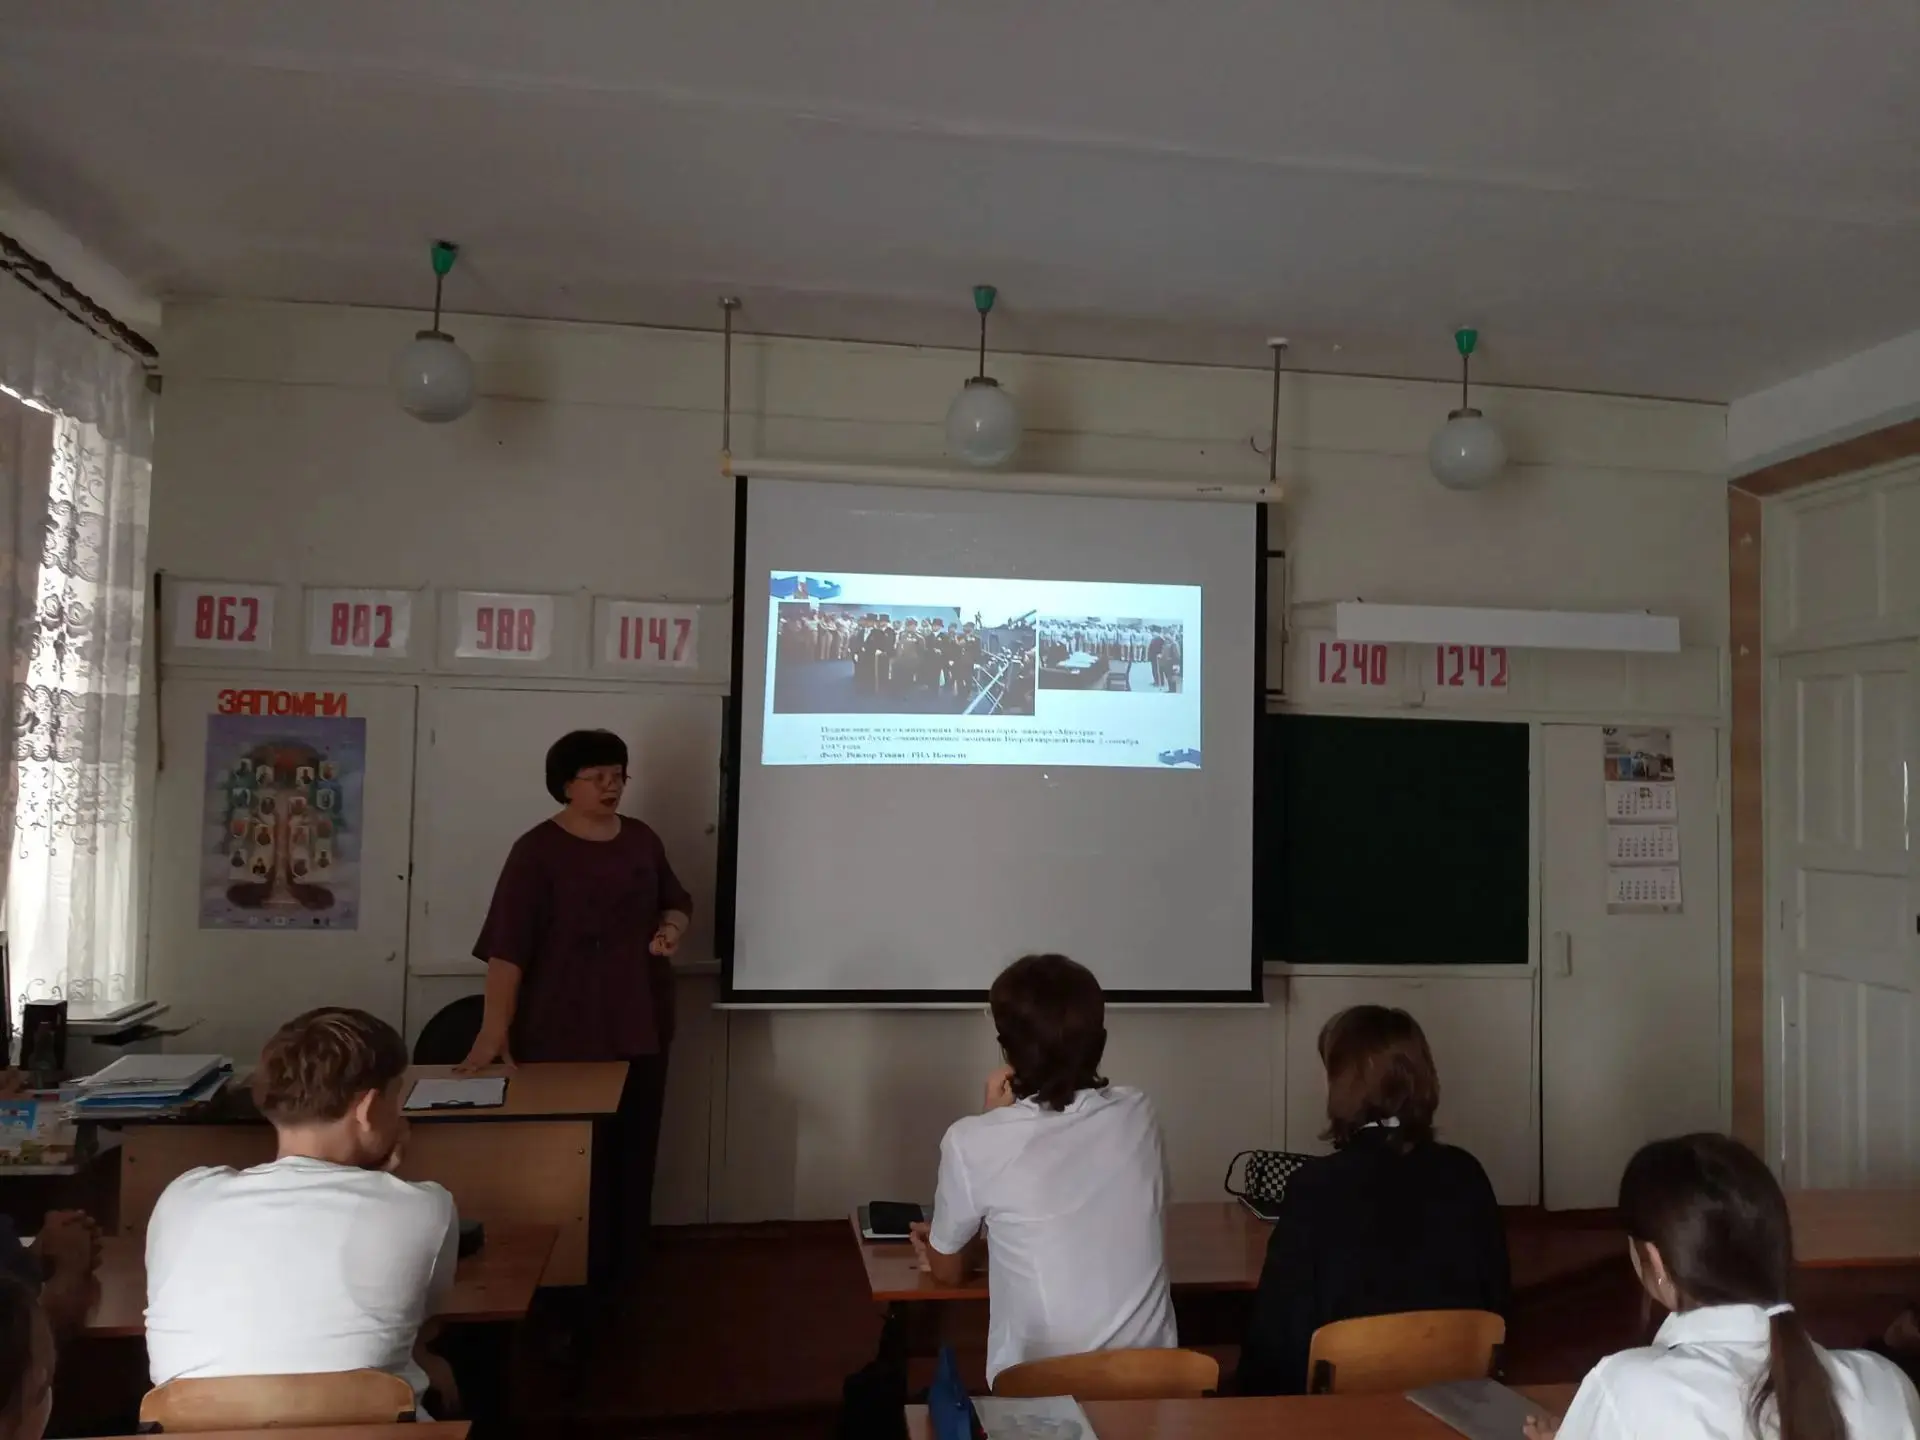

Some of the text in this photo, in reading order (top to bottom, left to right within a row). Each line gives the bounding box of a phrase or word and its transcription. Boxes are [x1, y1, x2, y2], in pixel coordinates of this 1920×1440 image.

[196, 595, 258, 641] 862
[331, 603, 392, 648] 882
[476, 608, 535, 651] 988
[619, 616, 692, 661] 1147
[1319, 642, 1387, 685] 1240
[1436, 645, 1508, 687] 1242
[217, 689, 348, 717] ЗАПОМНИ
